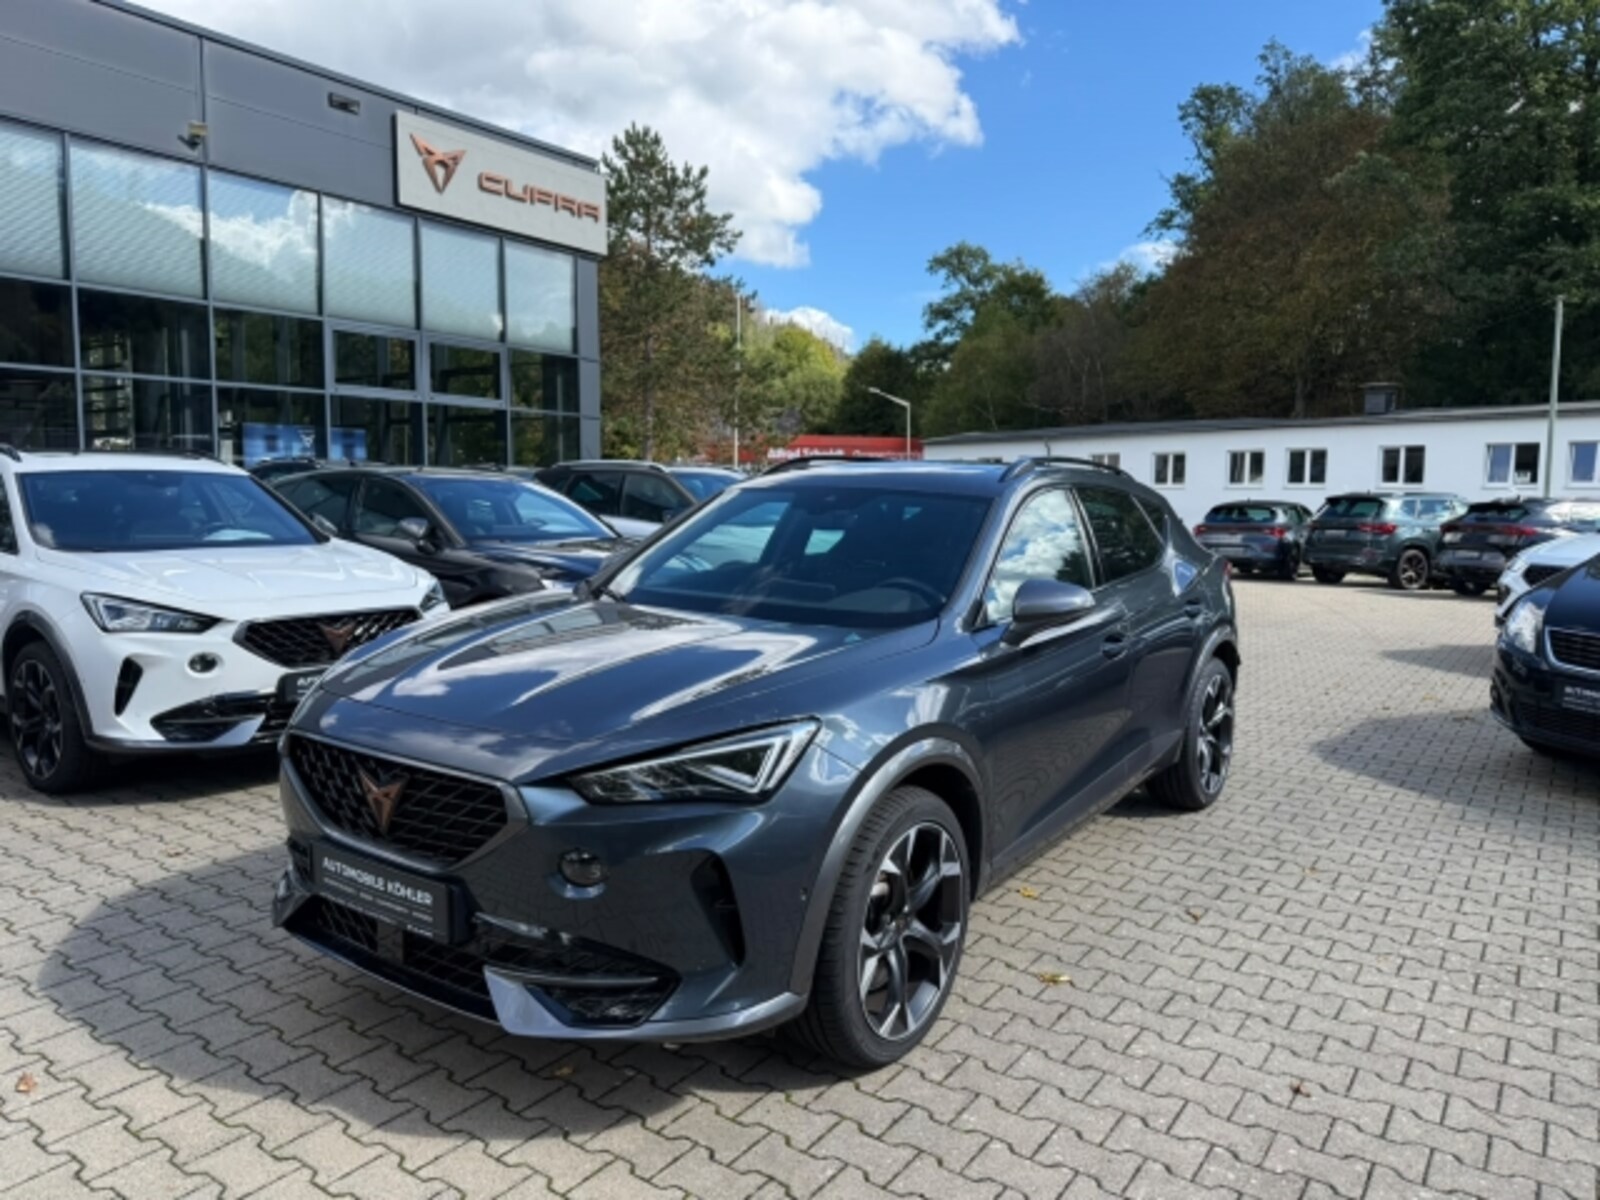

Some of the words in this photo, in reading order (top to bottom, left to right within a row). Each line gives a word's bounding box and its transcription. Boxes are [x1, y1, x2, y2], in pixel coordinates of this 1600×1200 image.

[478, 172, 600, 222] CUPRA
[322, 856, 385, 891] AUTOMOBILE
[386, 879, 433, 905] KÖHLER
